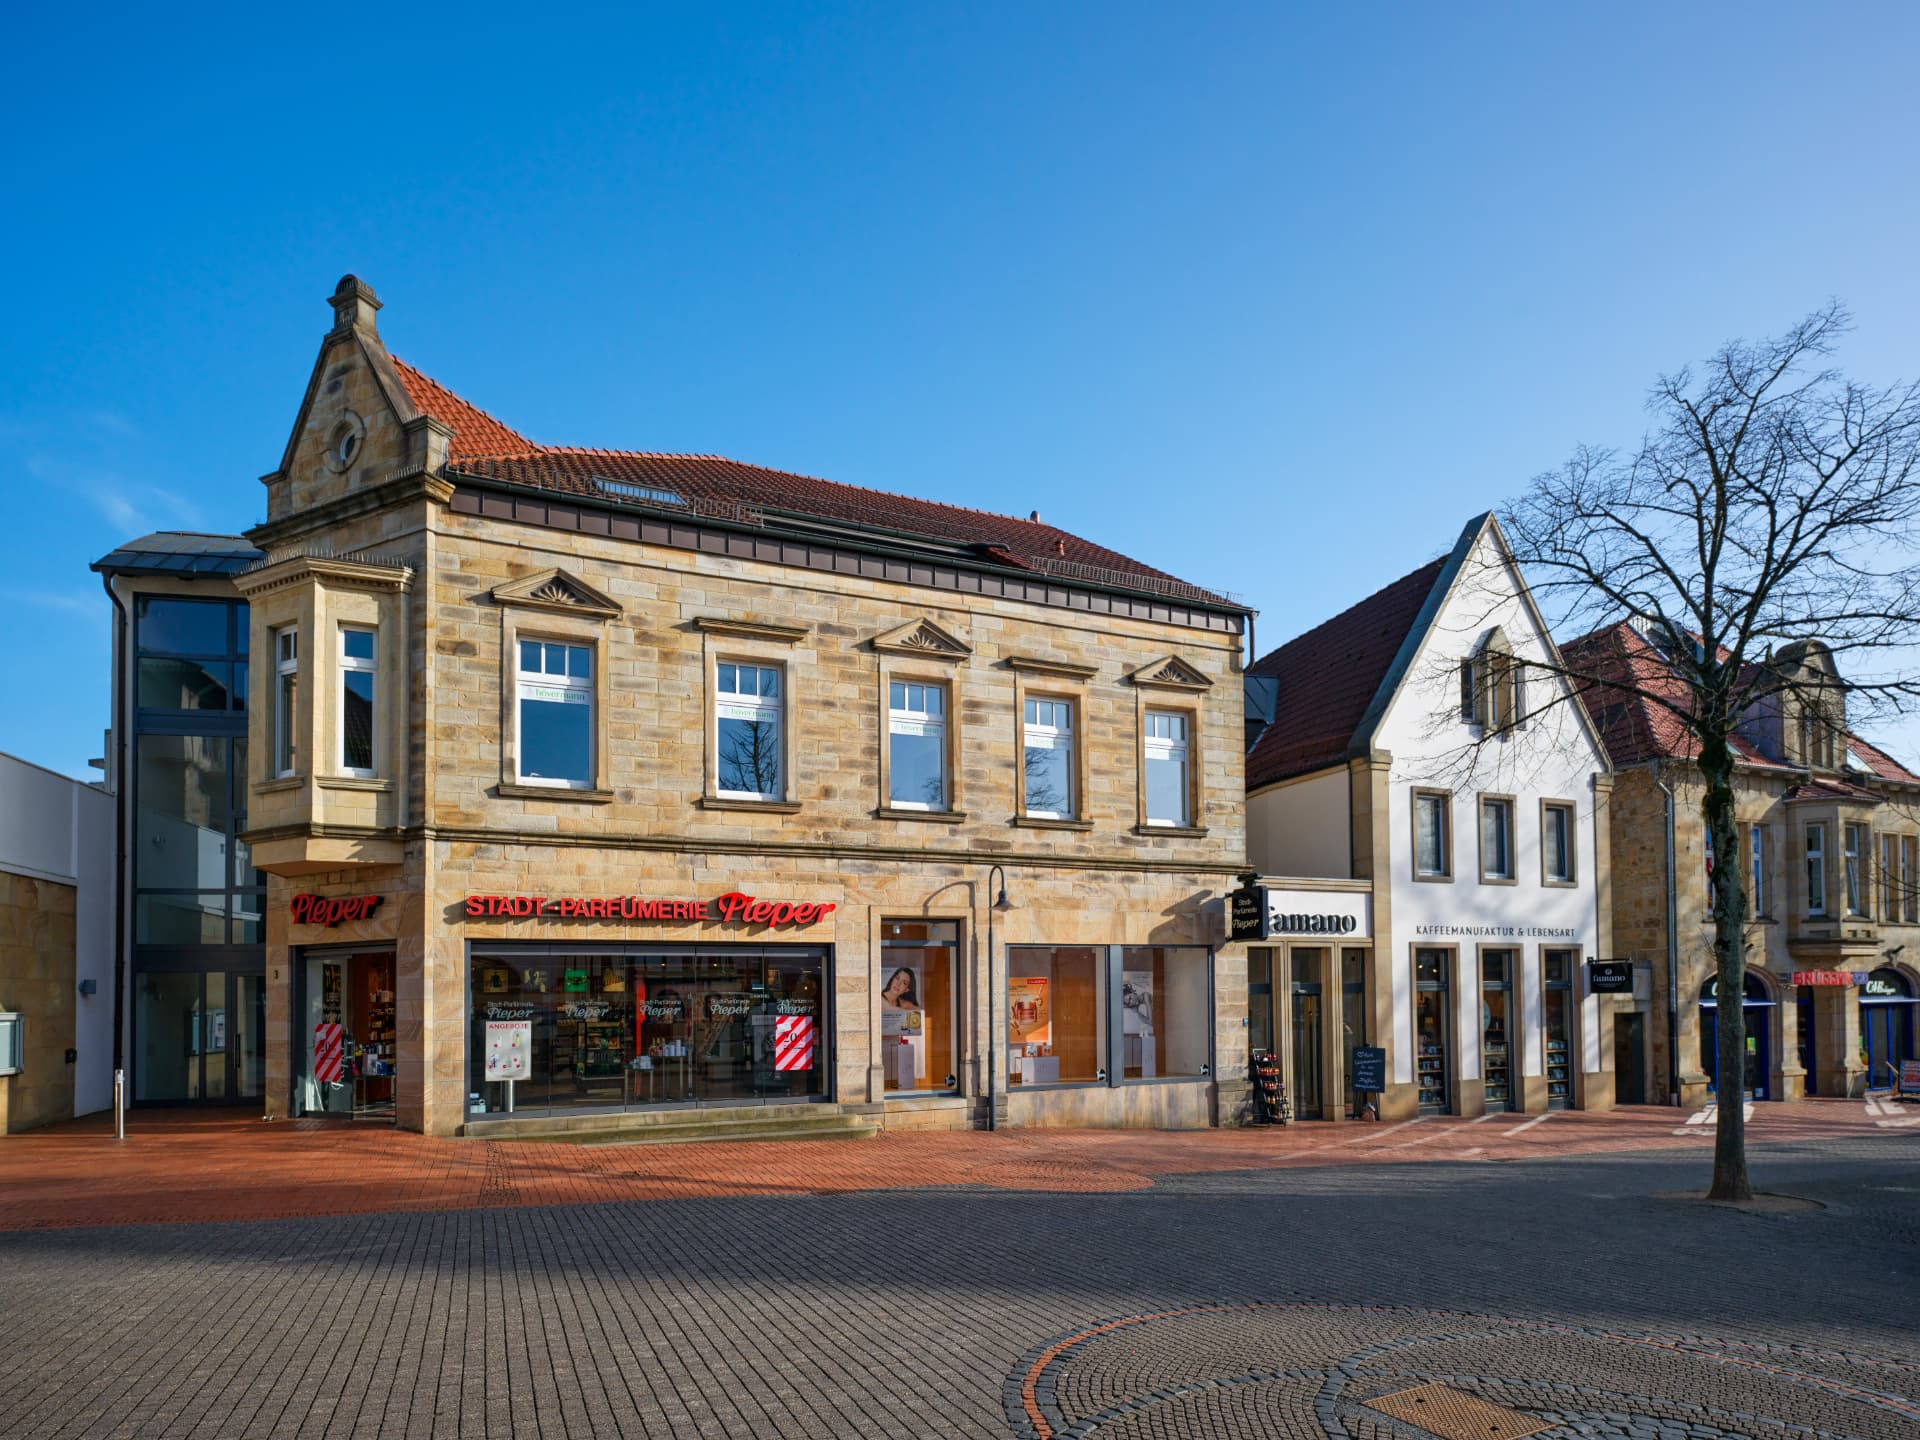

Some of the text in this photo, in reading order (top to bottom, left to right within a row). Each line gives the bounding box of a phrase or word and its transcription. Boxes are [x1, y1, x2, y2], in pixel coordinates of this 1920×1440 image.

[290, 892, 378, 928] Pieper
[718, 892, 836, 928] Pieper
[1268, 905, 1357, 933] amano
[1416, 925, 1576, 937] KAFFEEMANUFAKTUR & LEBENSART
[487, 1007, 535, 1020] Pieper
[640, 1005, 682, 1016] Pieper
[711, 1004, 750, 1016] Pieper
